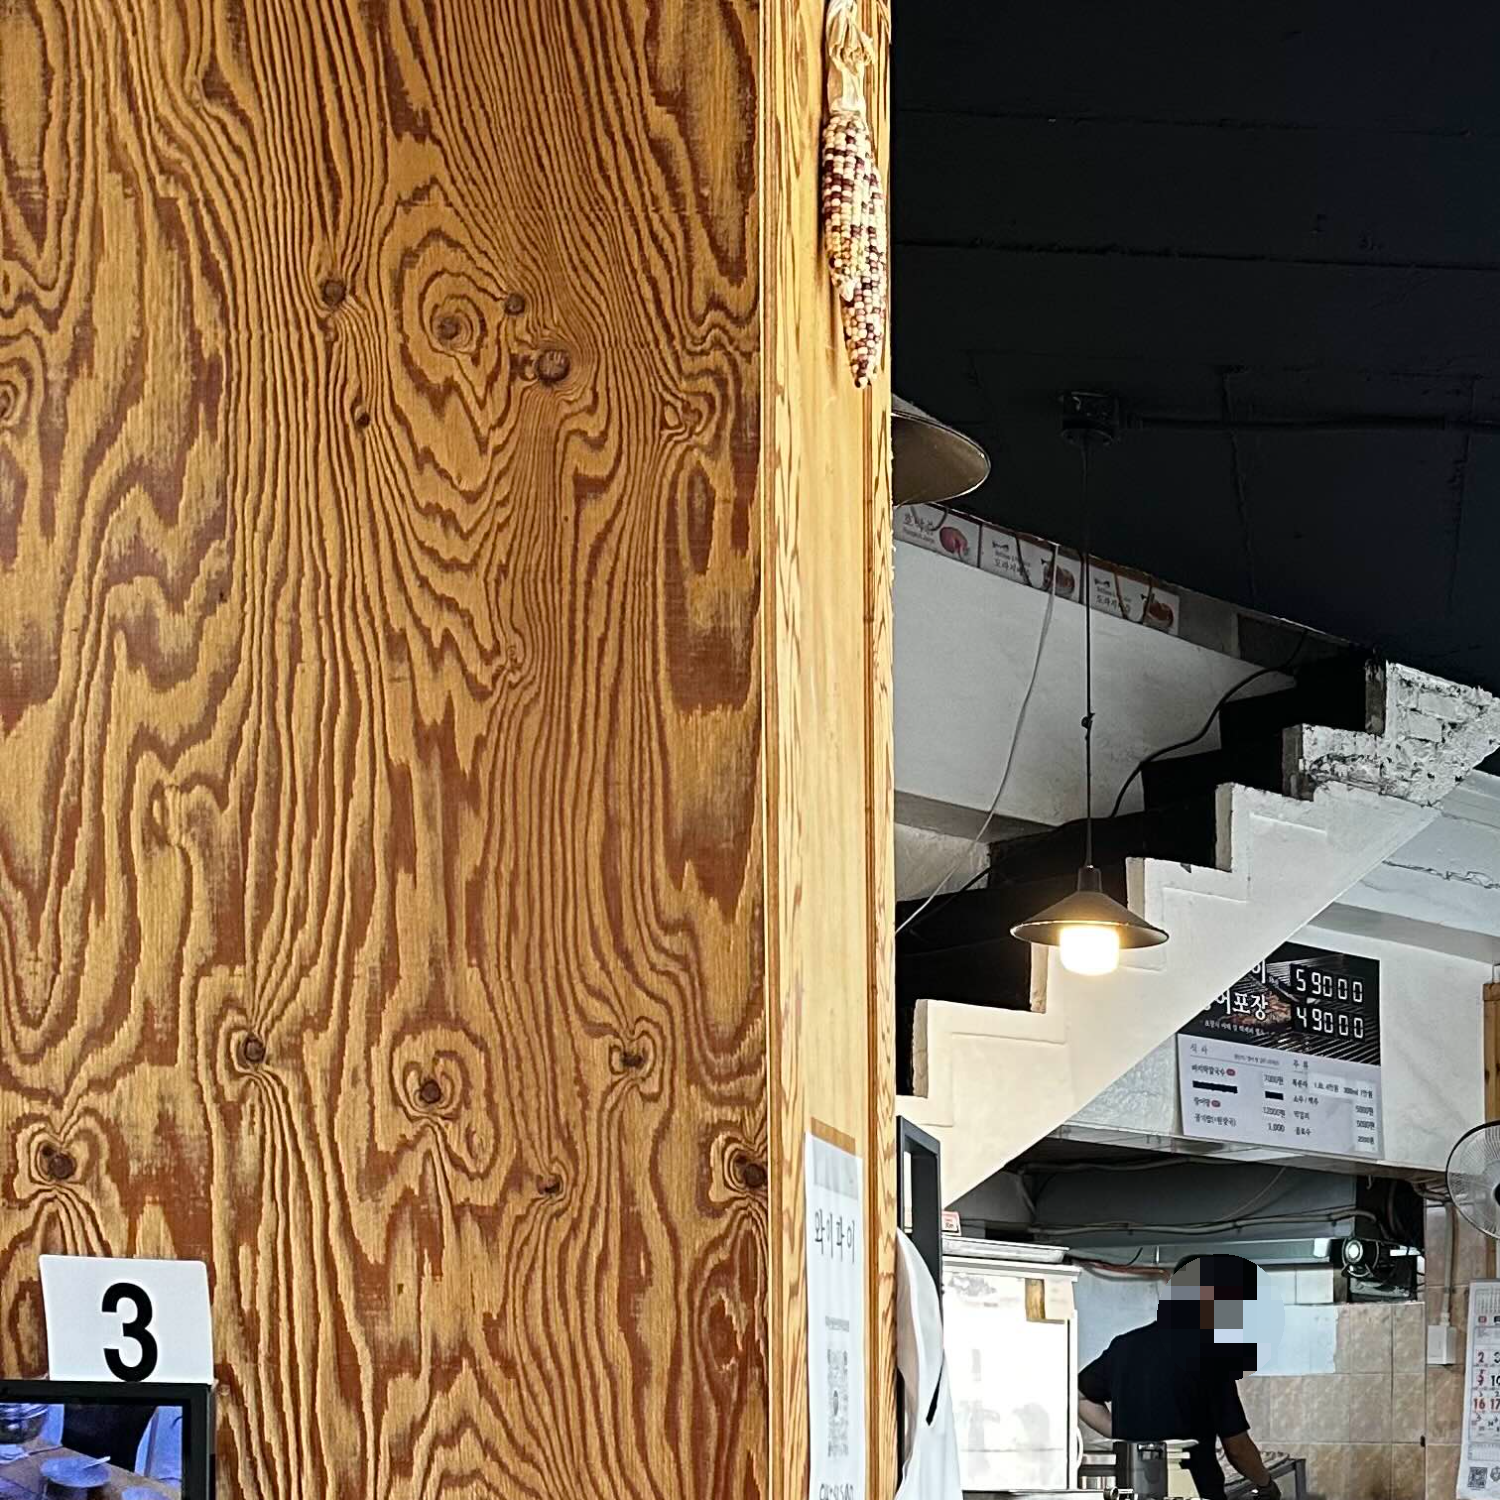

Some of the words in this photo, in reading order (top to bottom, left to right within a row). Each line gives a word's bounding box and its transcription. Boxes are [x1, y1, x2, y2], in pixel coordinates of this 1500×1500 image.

[1296, 968, 1363, 1003] 59000
[1204, 990, 1269, 1021] 어포장
[1296, 1006, 1364, 1039] 49000
[814, 1208, 856, 1264] 와이파이
[101, 1282, 158, 1382] 3
[1478, 1352, 1485, 1363] 2
[1493, 1352, 1500, 1363] 3
[1473, 1398, 1486, 1411] 16
